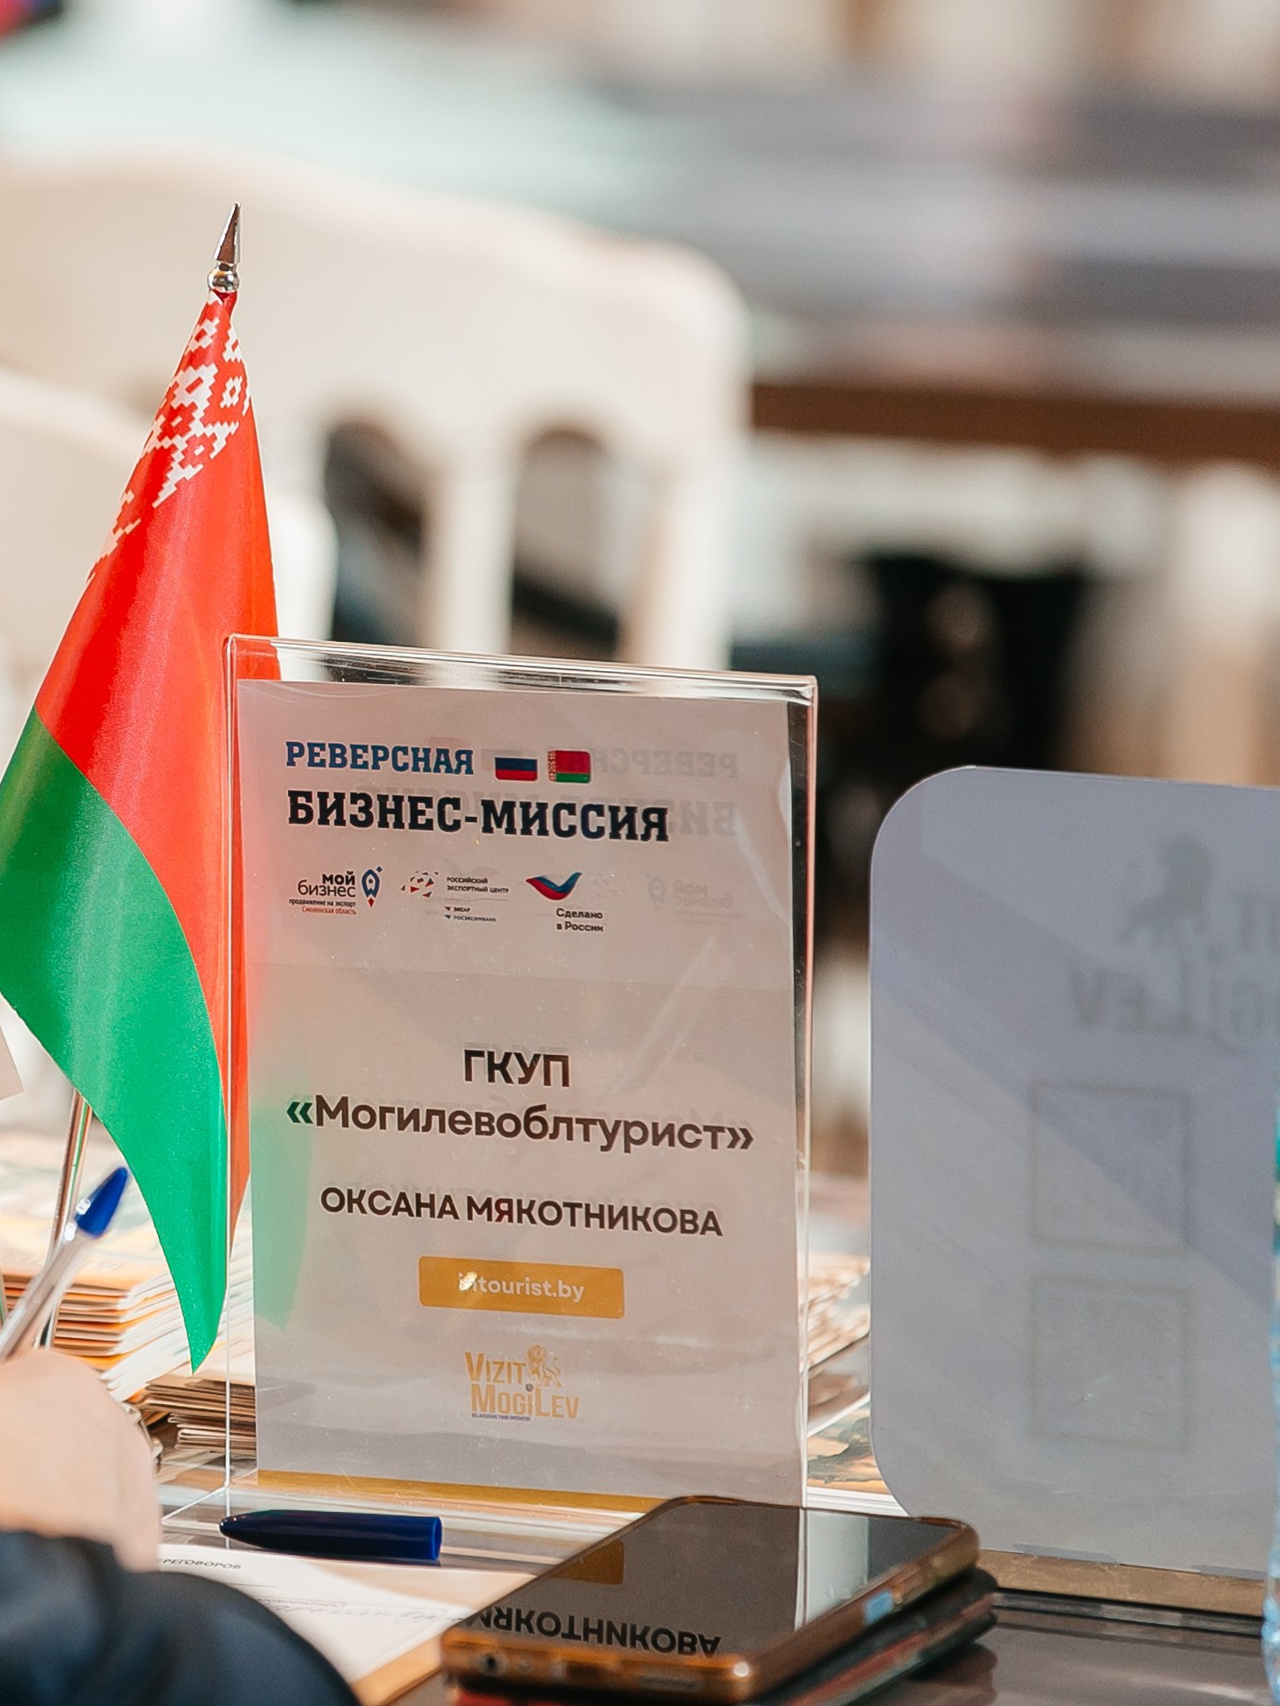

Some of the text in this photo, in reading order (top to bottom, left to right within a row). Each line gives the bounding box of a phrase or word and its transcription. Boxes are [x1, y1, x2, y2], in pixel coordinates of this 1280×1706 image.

[286, 741, 474, 775] РЕВЕРСНАЯ
[287, 790, 669, 842] БИЗНЕС-МИССИЯ
[297, 879, 356, 898] бизнес
[322, 871, 356, 885] мой
[556, 908, 604, 920] Сделано
[565, 921, 604, 932] России
[464, 1049, 570, 1087] ГКУП
[286, 1095, 754, 1153] «Могилевоблтурист»
[321, 1186, 723, 1237] ОКСАНА МЯКОТНИКОВА
[458, 1271, 584, 1303] tourist.by
[158, 1558, 242, 1570] РЕГОВОРОВ
